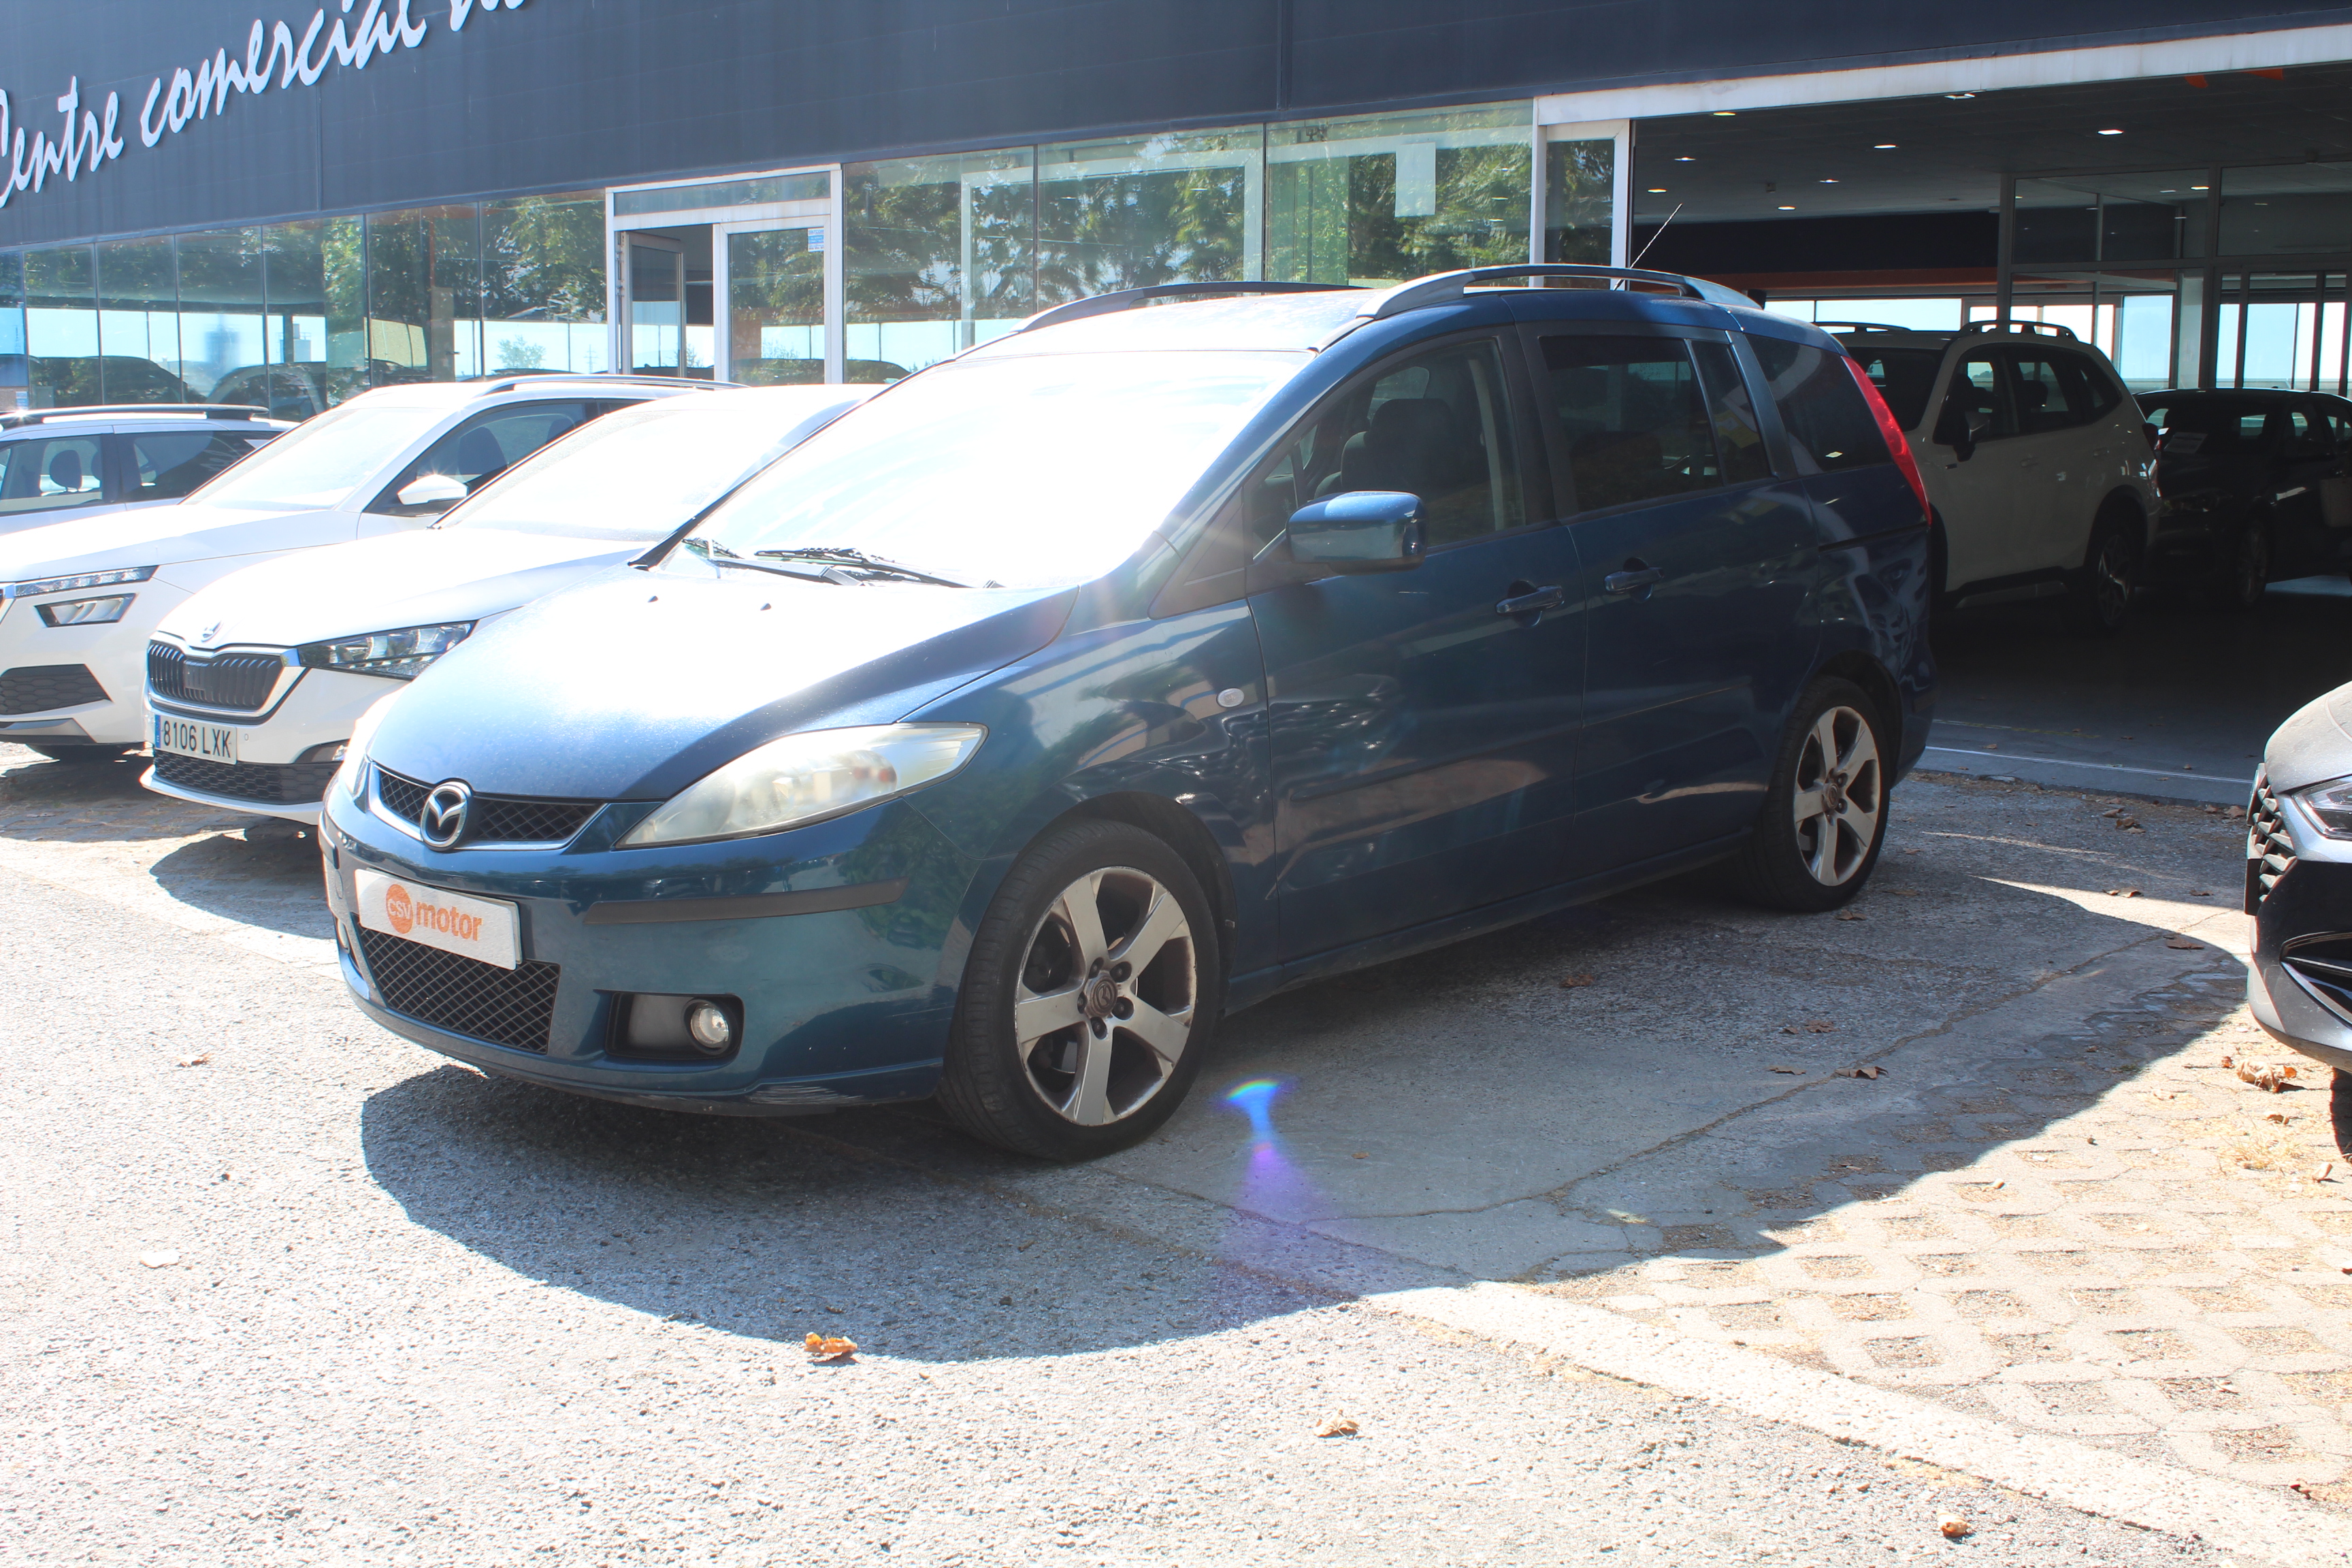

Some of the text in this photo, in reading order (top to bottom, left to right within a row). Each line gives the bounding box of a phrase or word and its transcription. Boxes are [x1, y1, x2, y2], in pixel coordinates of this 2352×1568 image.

[164, 720, 231, 758] 8106 LXK
[416, 901, 483, 941] motor
